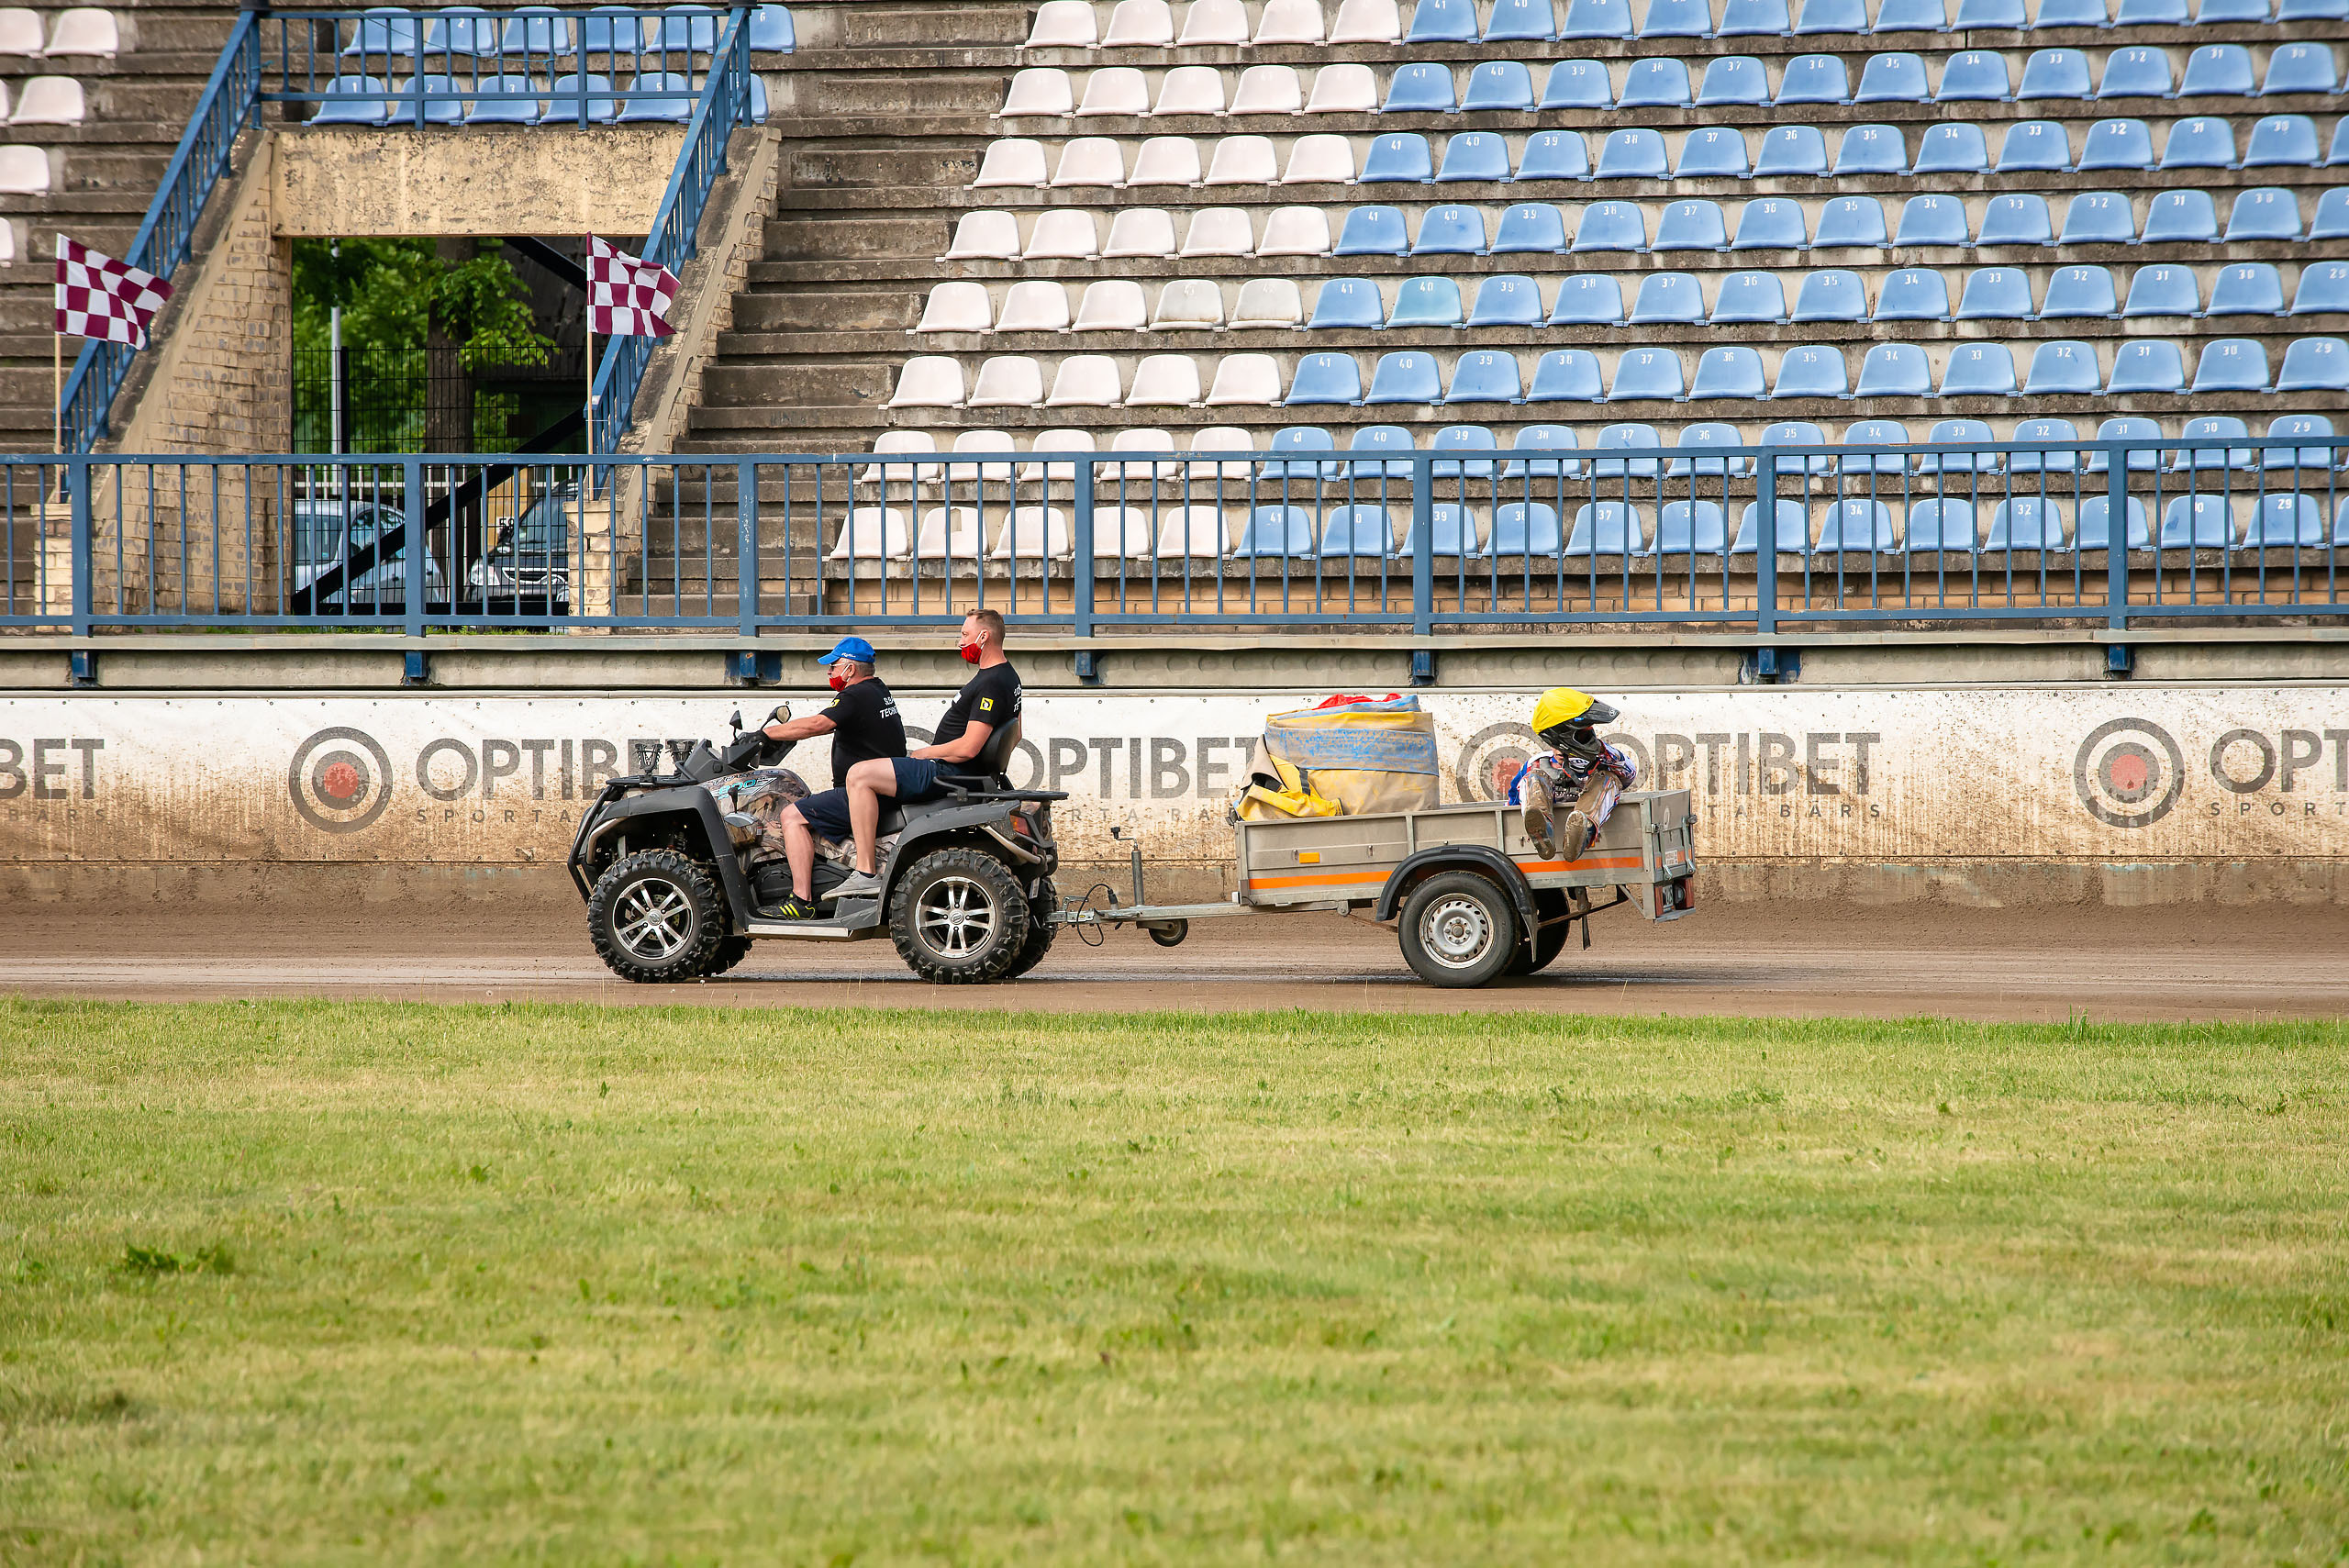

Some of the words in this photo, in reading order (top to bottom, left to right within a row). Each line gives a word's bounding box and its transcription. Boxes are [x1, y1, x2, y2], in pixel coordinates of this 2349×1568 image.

[760, 11, 766, 22] 6
[1966, 53, 1981, 66] 34
[2049, 53, 2064, 64] 33
[2129, 50, 2147, 62] 32
[1490, 65, 1505, 77] 40
[1571, 65, 1586, 77] 39
[1651, 61, 1664, 73] 38
[1727, 61, 1742, 72] 37
[1411, 67, 1427, 79] 41
[427, 83, 434, 94] 2
[1785, 128, 1798, 140] 36
[1863, 129, 1878, 141] 35
[1944, 127, 1959, 139] 34
[2028, 125, 2042, 137] 33
[2110, 122, 2128, 136] 32
[1465, 136, 1481, 148] 40
[1543, 136, 1559, 148] 39
[1706, 131, 1719, 143] 37
[1390, 139, 1403, 151] 41
[1844, 200, 1858, 212] 35
[1923, 197, 1938, 209] 34
[2009, 197, 2024, 210] 33
[2090, 196, 2109, 209] 32
[2173, 194, 2186, 206] 31
[1522, 208, 1537, 220] 39
[1603, 205, 1618, 217] 38
[1683, 205, 1698, 217] 37
[1764, 202, 1777, 214] 36
[1367, 210, 1378, 221] 41
[1443, 209, 1458, 221] 40
[1743, 275, 1758, 287] 36
[1822, 274, 1838, 287] 35
[1904, 273, 1919, 285] 34
[1988, 272, 2002, 284] 33
[2073, 269, 2088, 282] 32
[2155, 270, 2169, 282] 31
[1419, 281, 1434, 294] 40
[1500, 282, 1515, 294] 39
[1580, 278, 1597, 290] 38
[1661, 276, 1677, 289] 37
[1341, 283, 1353, 295] 41
[1722, 351, 1734, 362] 36
[1803, 351, 1818, 363] 35
[1885, 350, 1898, 361] 34
[1970, 349, 1983, 361] 33
[2056, 346, 2072, 359] 32
[2137, 345, 2151, 357] 31
[1318, 356, 1331, 368] 41
[1398, 358, 1413, 370] 40
[1478, 354, 1494, 366] 39
[1558, 353, 1573, 366] 38
[1641, 352, 1654, 365] 37
[1784, 428, 1798, 439] 35
[1868, 426, 1882, 438] 34
[1953, 425, 1966, 437] 33
[2036, 425, 2050, 437] 32
[2117, 423, 2129, 436] 31
[2203, 421, 2219, 434] 30
[2292, 421, 2311, 434] 29
[1292, 430, 1303, 444] 41
[1373, 431, 1387, 443] 40
[1454, 429, 1469, 441] 39
[1621, 428, 1633, 440] 37
[1698, 428, 1710, 441] 36
[1849, 504, 1863, 517] 34
[2017, 503, 2032, 517] 32
[2277, 498, 2293, 511] 29
[1269, 511, 1282, 524] 41
[1433, 510, 1447, 522] 39
[1598, 507, 1613, 521] 37
[2210, 728, 2349, 794] OPT
[0, 738, 105, 800] BET
[416, 809, 573, 823] SPORTA
